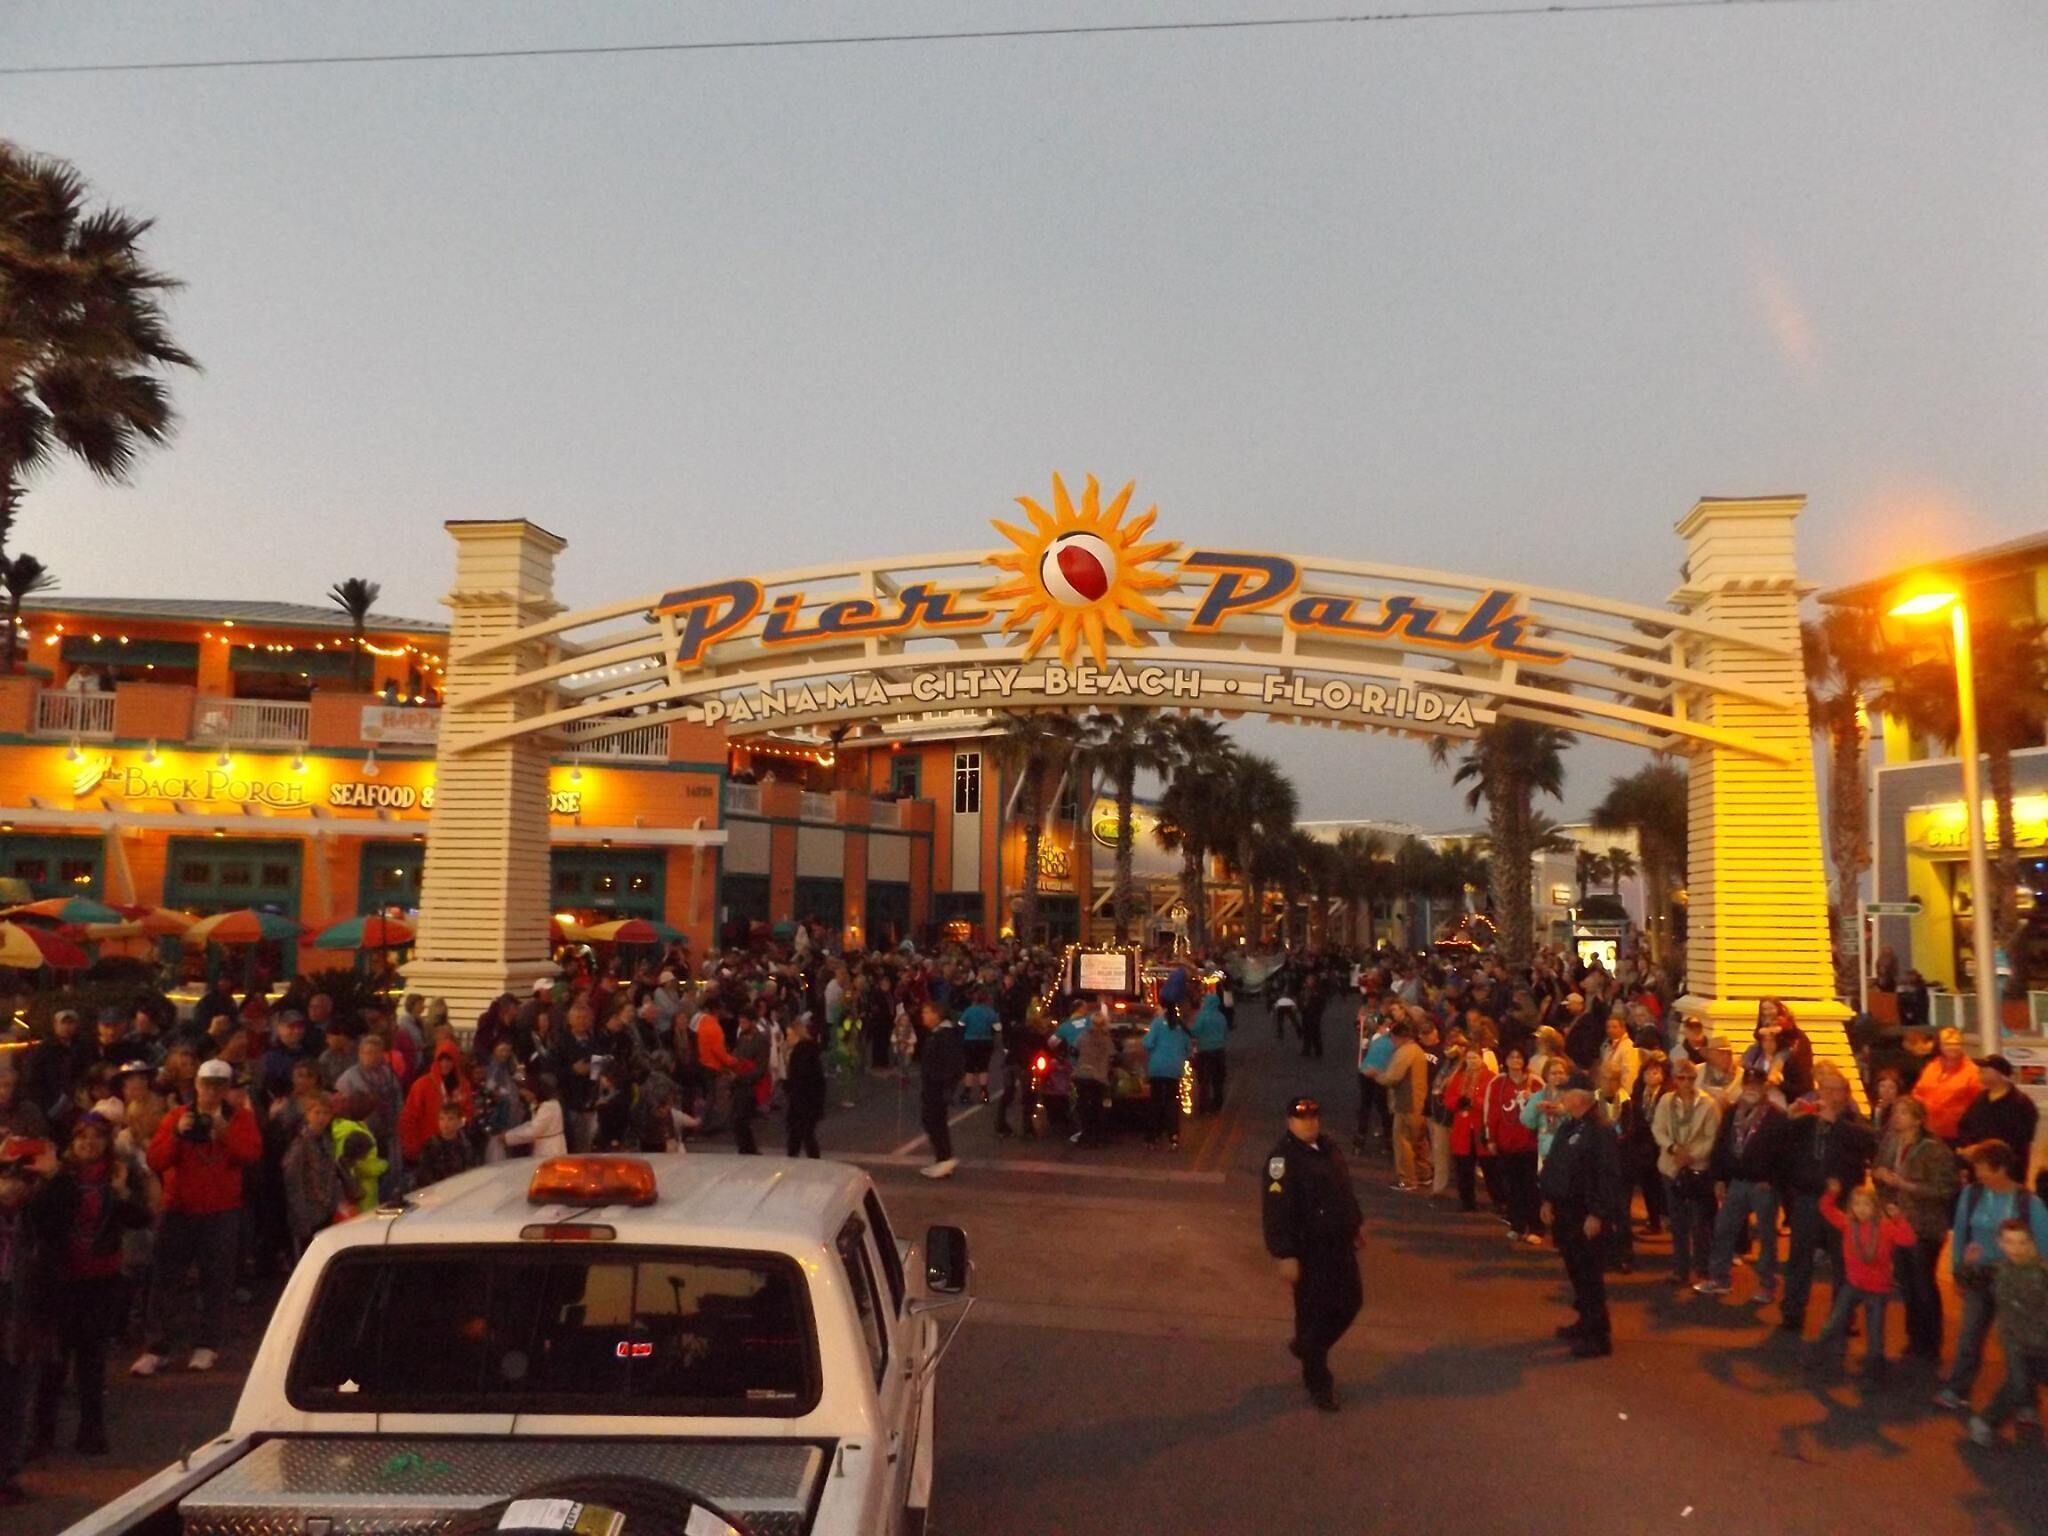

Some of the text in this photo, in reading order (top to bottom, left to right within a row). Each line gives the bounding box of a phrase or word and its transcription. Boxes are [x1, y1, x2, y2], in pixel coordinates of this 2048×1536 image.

[655, 549, 1570, 669] Pier Park
[702, 666, 1477, 730] PANAMA CITY BEACH FLORIDA
[123, 766, 199, 799] BACK
[204, 769, 305, 805] PORCH
[329, 783, 417, 810] SEAFOOD
